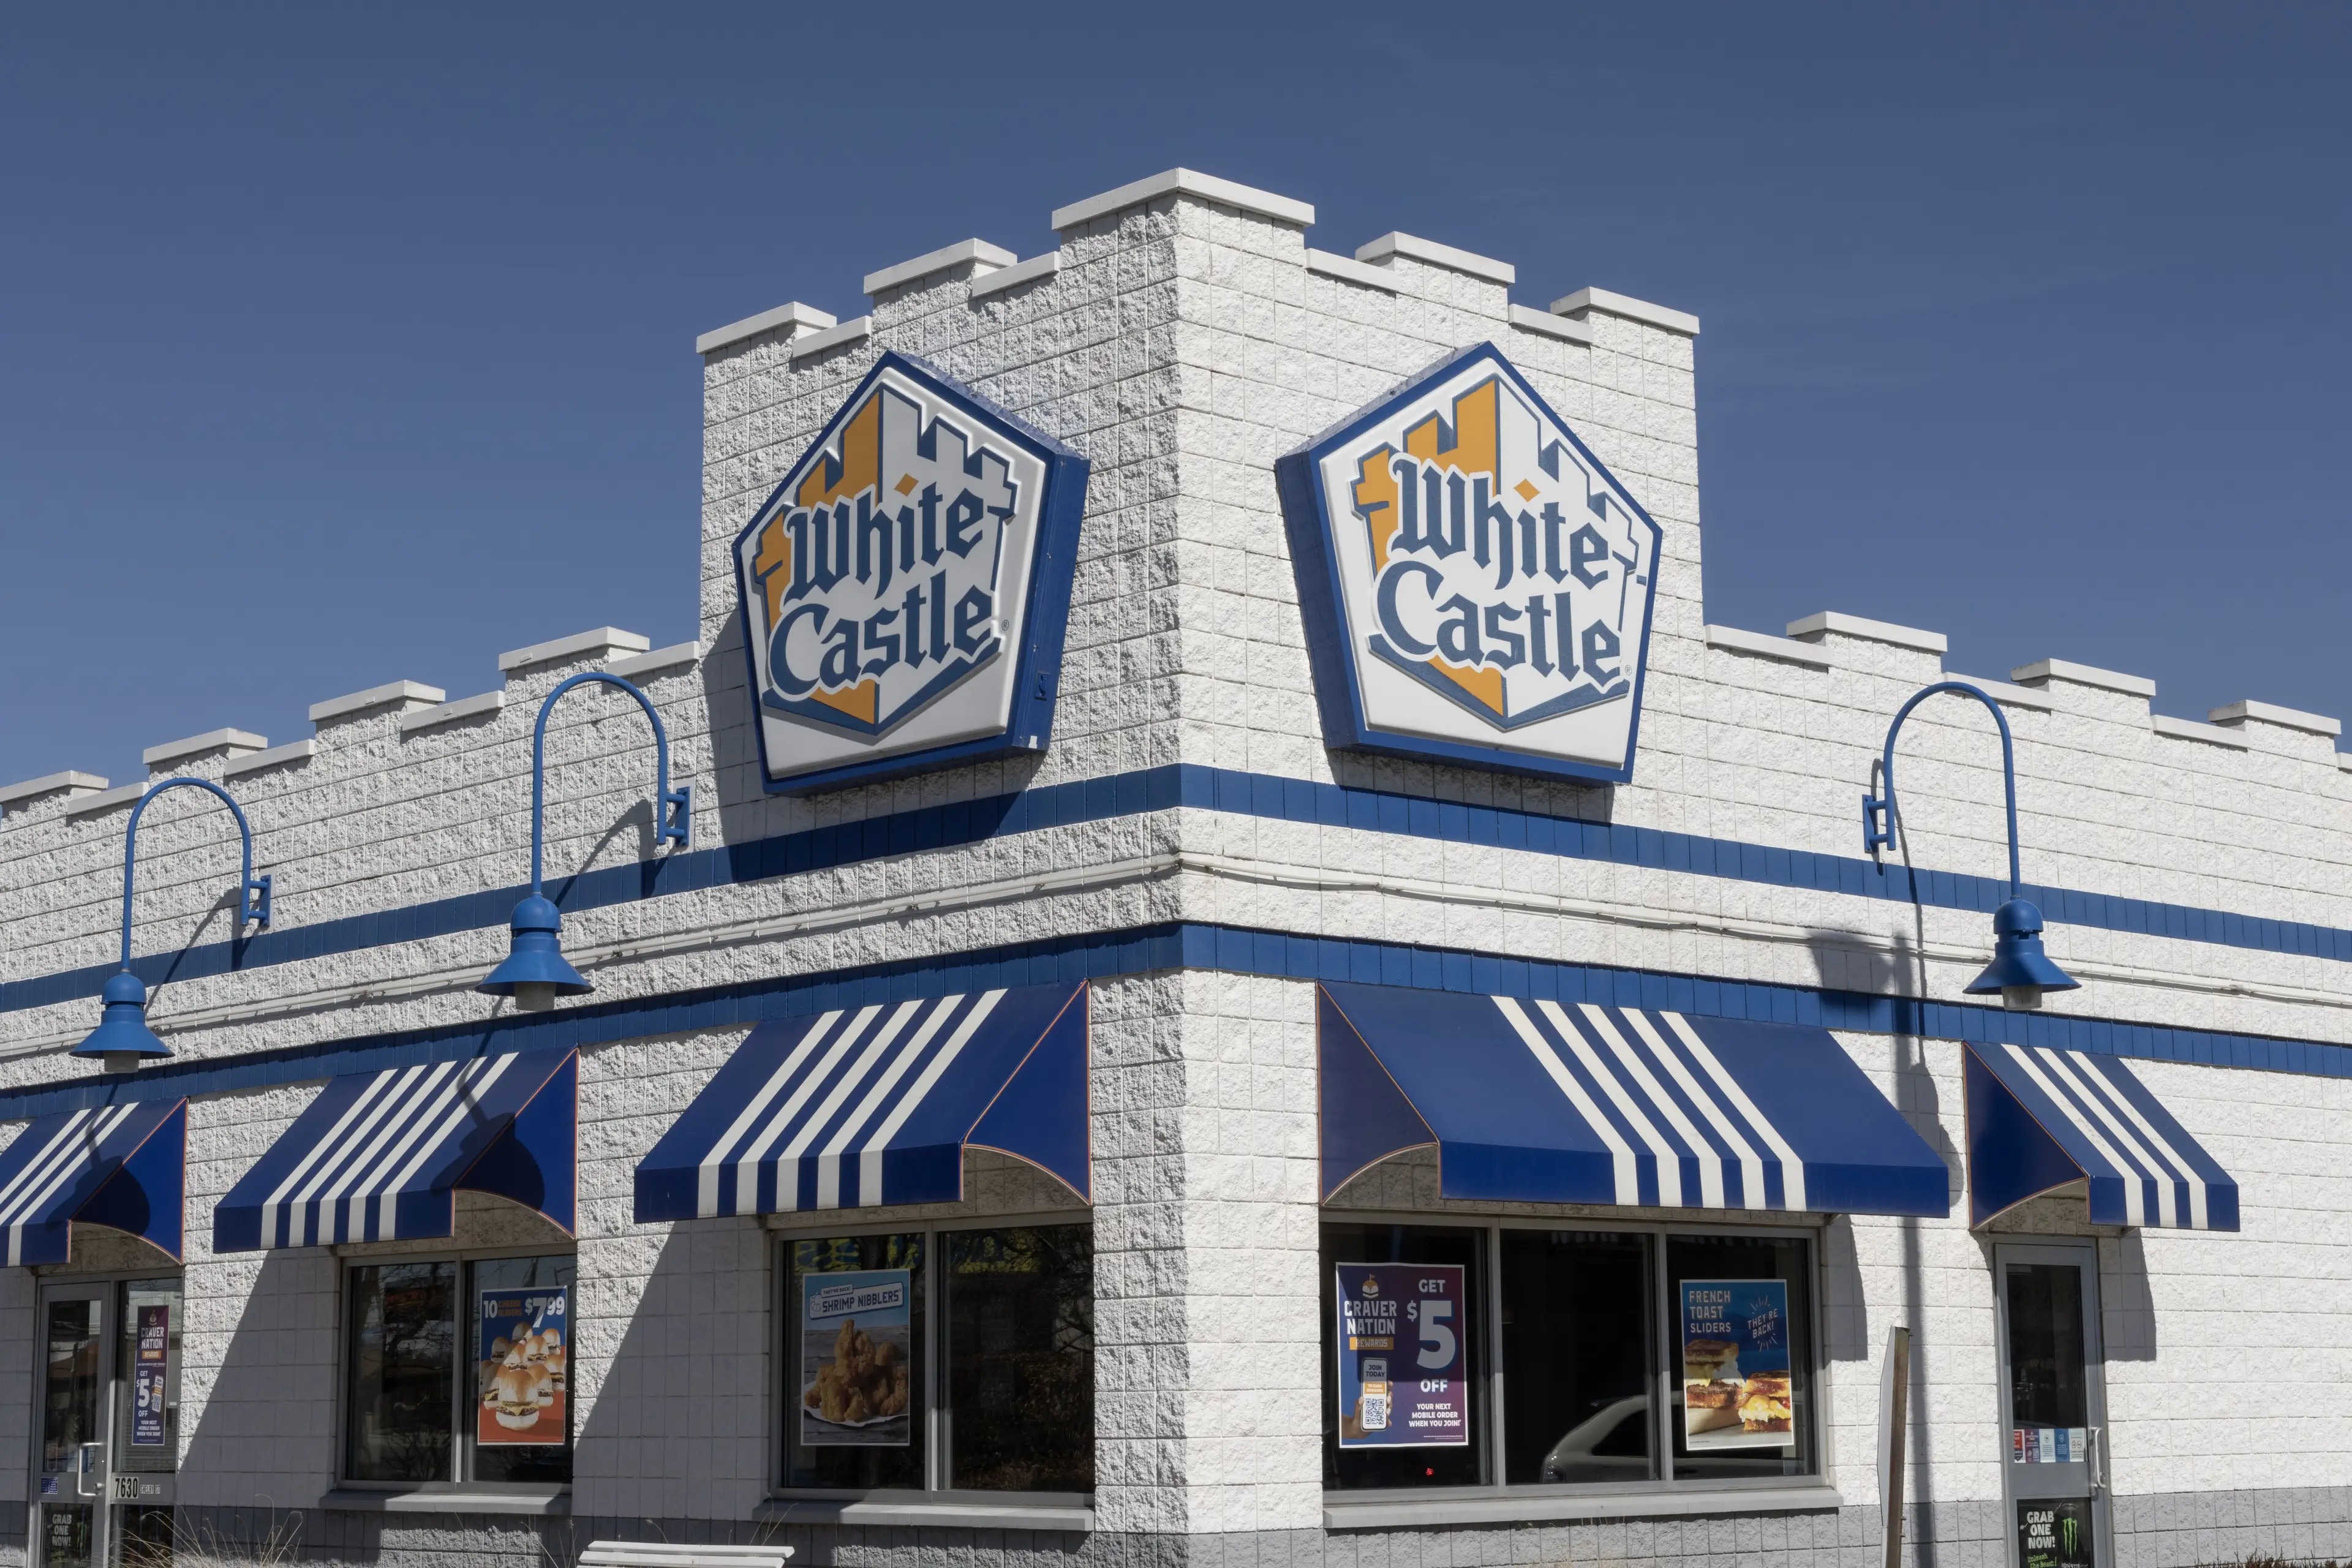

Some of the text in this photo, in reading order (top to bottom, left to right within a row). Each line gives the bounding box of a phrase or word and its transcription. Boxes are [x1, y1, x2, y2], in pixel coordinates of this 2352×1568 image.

[1391, 459, 1608, 590] White
[785, 473, 984, 602] White
[1377, 560, 1621, 687] Castle
[770, 568, 993, 696] Castle
[1419, 1279, 1446, 1292] GET
[1689, 1291, 1731, 1303] FRENCH
[483, 1300, 497, 1318] 10
[822, 1297, 854, 1313] SHRIMP
[1344, 1300, 1397, 1316] CRAVER
[1689, 1306, 1724, 1319] TOAST
[141, 1327, 164, 1337] CRAVER
[1347, 1319, 1395, 1334] NATION
[1690, 1322, 1732, 1333] SLIDERS
[1753, 1321, 1774, 1338] BACK!
[141, 1338, 163, 1349] NATION
[1355, 1339, 1388, 1348] REWARDS
[1420, 1379, 1448, 1392] OFF
[115, 1477, 160, 1498] 7630 SHELBY ST
[52, 1514, 72, 1525] GRAB
[2027, 1510, 2054, 1524] GRAB
[54, 1525, 69, 1535] ONE
[2030, 1524, 2051, 1536] ONE
[51, 1536, 71, 1546] NOW!
[2028, 1536, 2056, 1549] NOW!
[2027, 1553, 2048, 1562] Unleash
